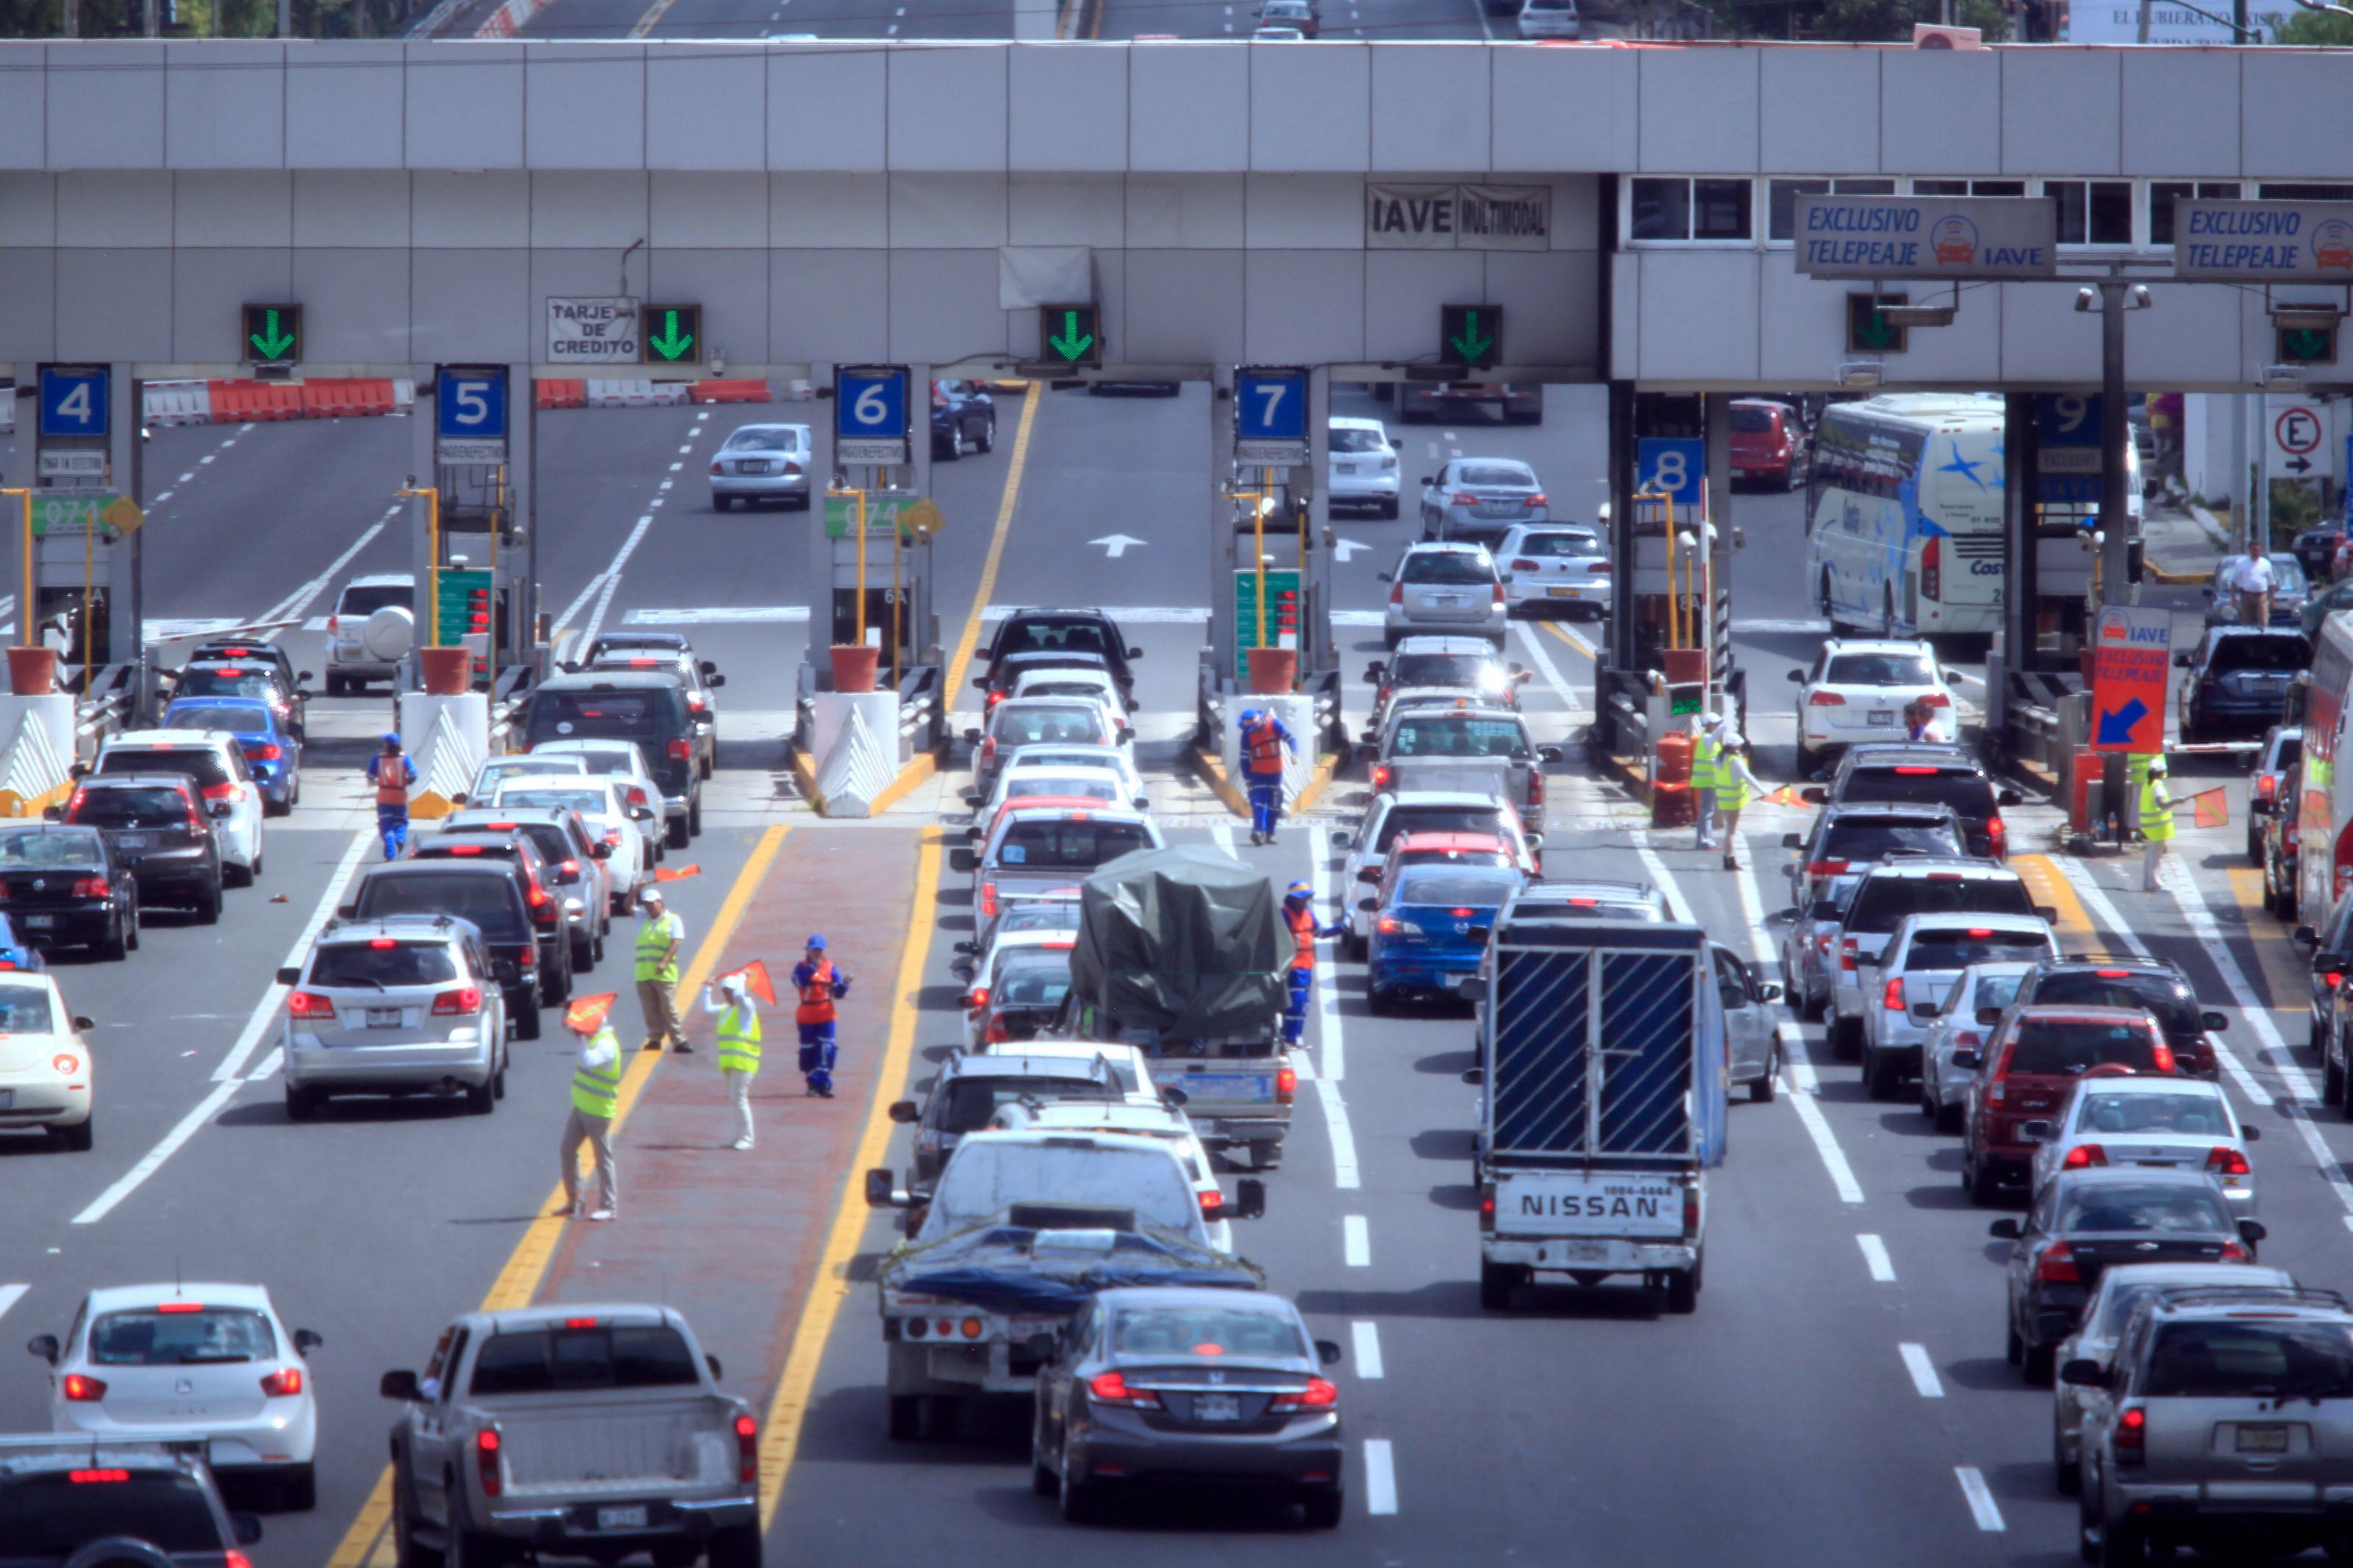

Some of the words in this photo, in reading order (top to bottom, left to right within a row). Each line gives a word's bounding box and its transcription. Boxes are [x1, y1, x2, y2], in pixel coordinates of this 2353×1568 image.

[2113, 10, 2131, 24] EL
[1372, 199, 1452, 233] IAVE
[1807, 207, 1921, 233] EXCLUSIVO
[2188, 210, 2302, 236] EXCLUSIVO
[1807, 240, 1920, 266] TELEPEAJE
[1985, 247, 2045, 266] IAVE
[2188, 244, 2299, 269] TELEPEAJE
[552, 305, 636, 319] TARJEA
[582, 323, 606, 337] DE
[553, 340, 635, 354] CREDITO
[56, 382, 91, 424] 4
[455, 382, 489, 425] 5
[854, 383, 888, 425] 6
[1255, 385, 1287, 427] 7
[2054, 396, 2087, 433] 9
[2288, 417, 2310, 446] E
[1655, 451, 1688, 492] 8
[2129, 627, 2168, 643] IAVE
[1521, 1195, 1658, 1218] NISSAN
